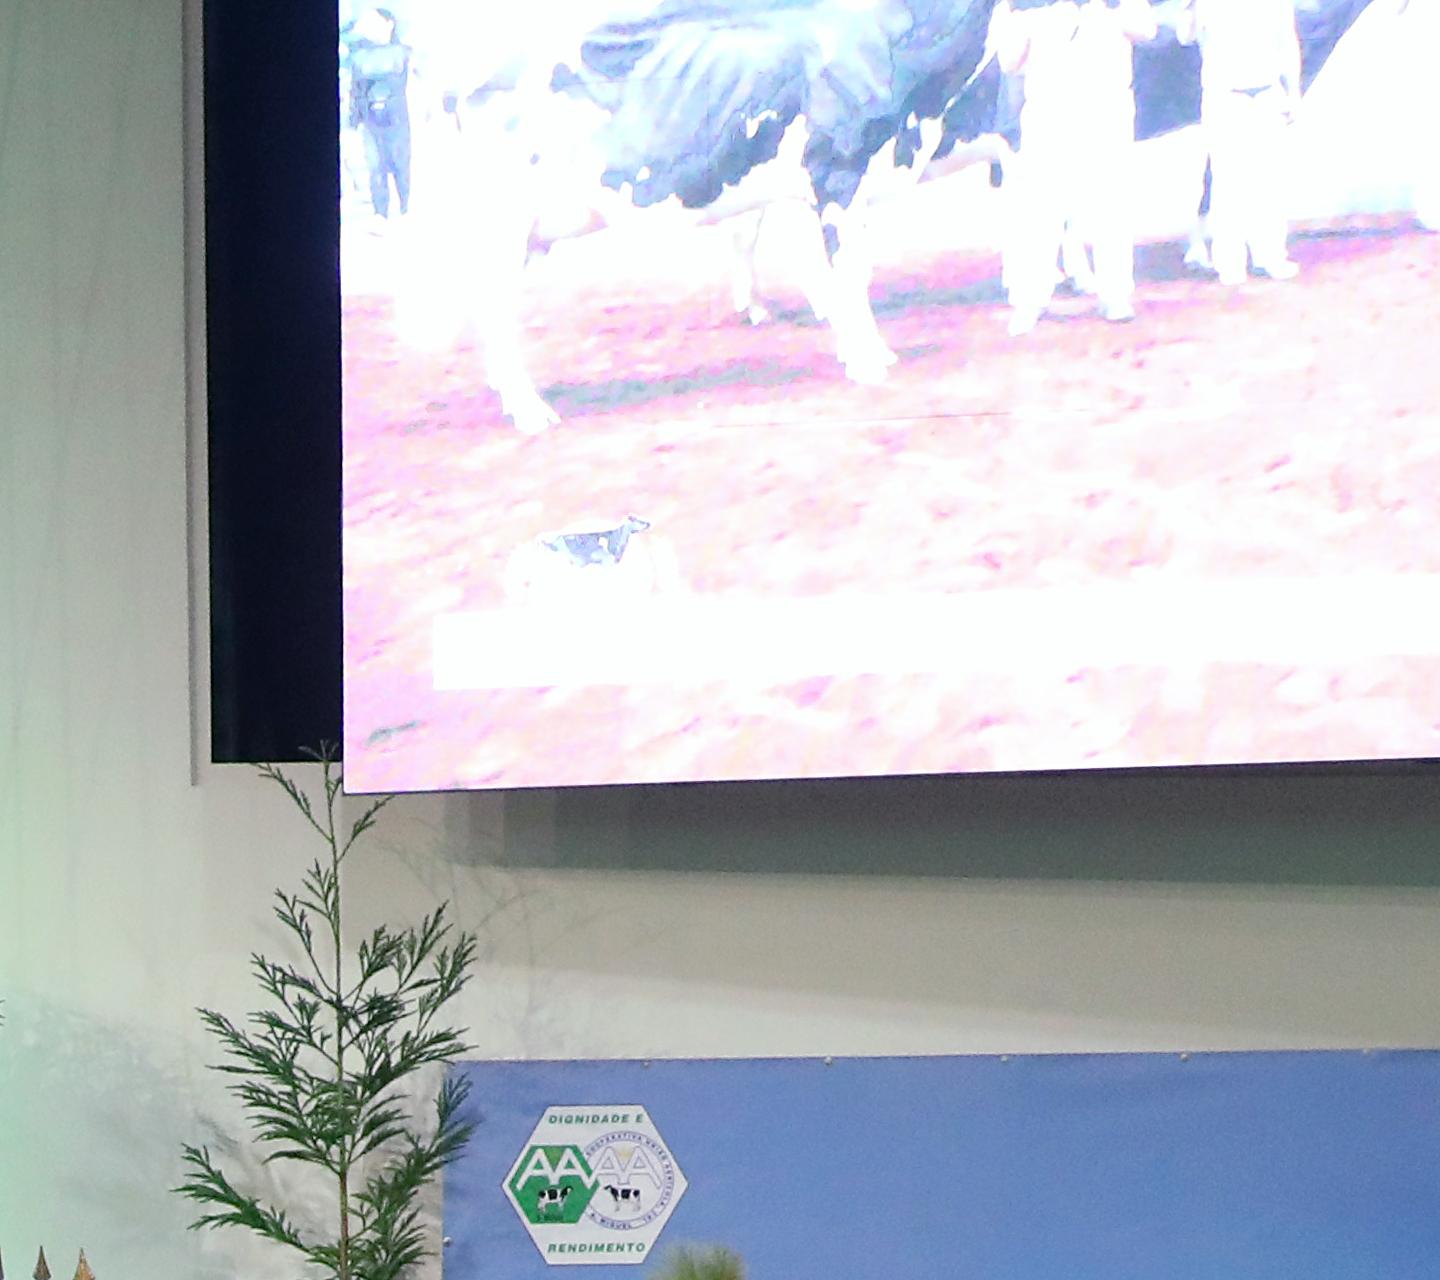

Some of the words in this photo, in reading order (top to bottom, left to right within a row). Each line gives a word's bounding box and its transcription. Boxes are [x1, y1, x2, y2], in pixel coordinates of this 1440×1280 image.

[548, 1114, 630, 1124] DIGNIDADE
[635, 1113, 644, 1123] E
[548, 1242, 645, 1253] RENDIMENTO
